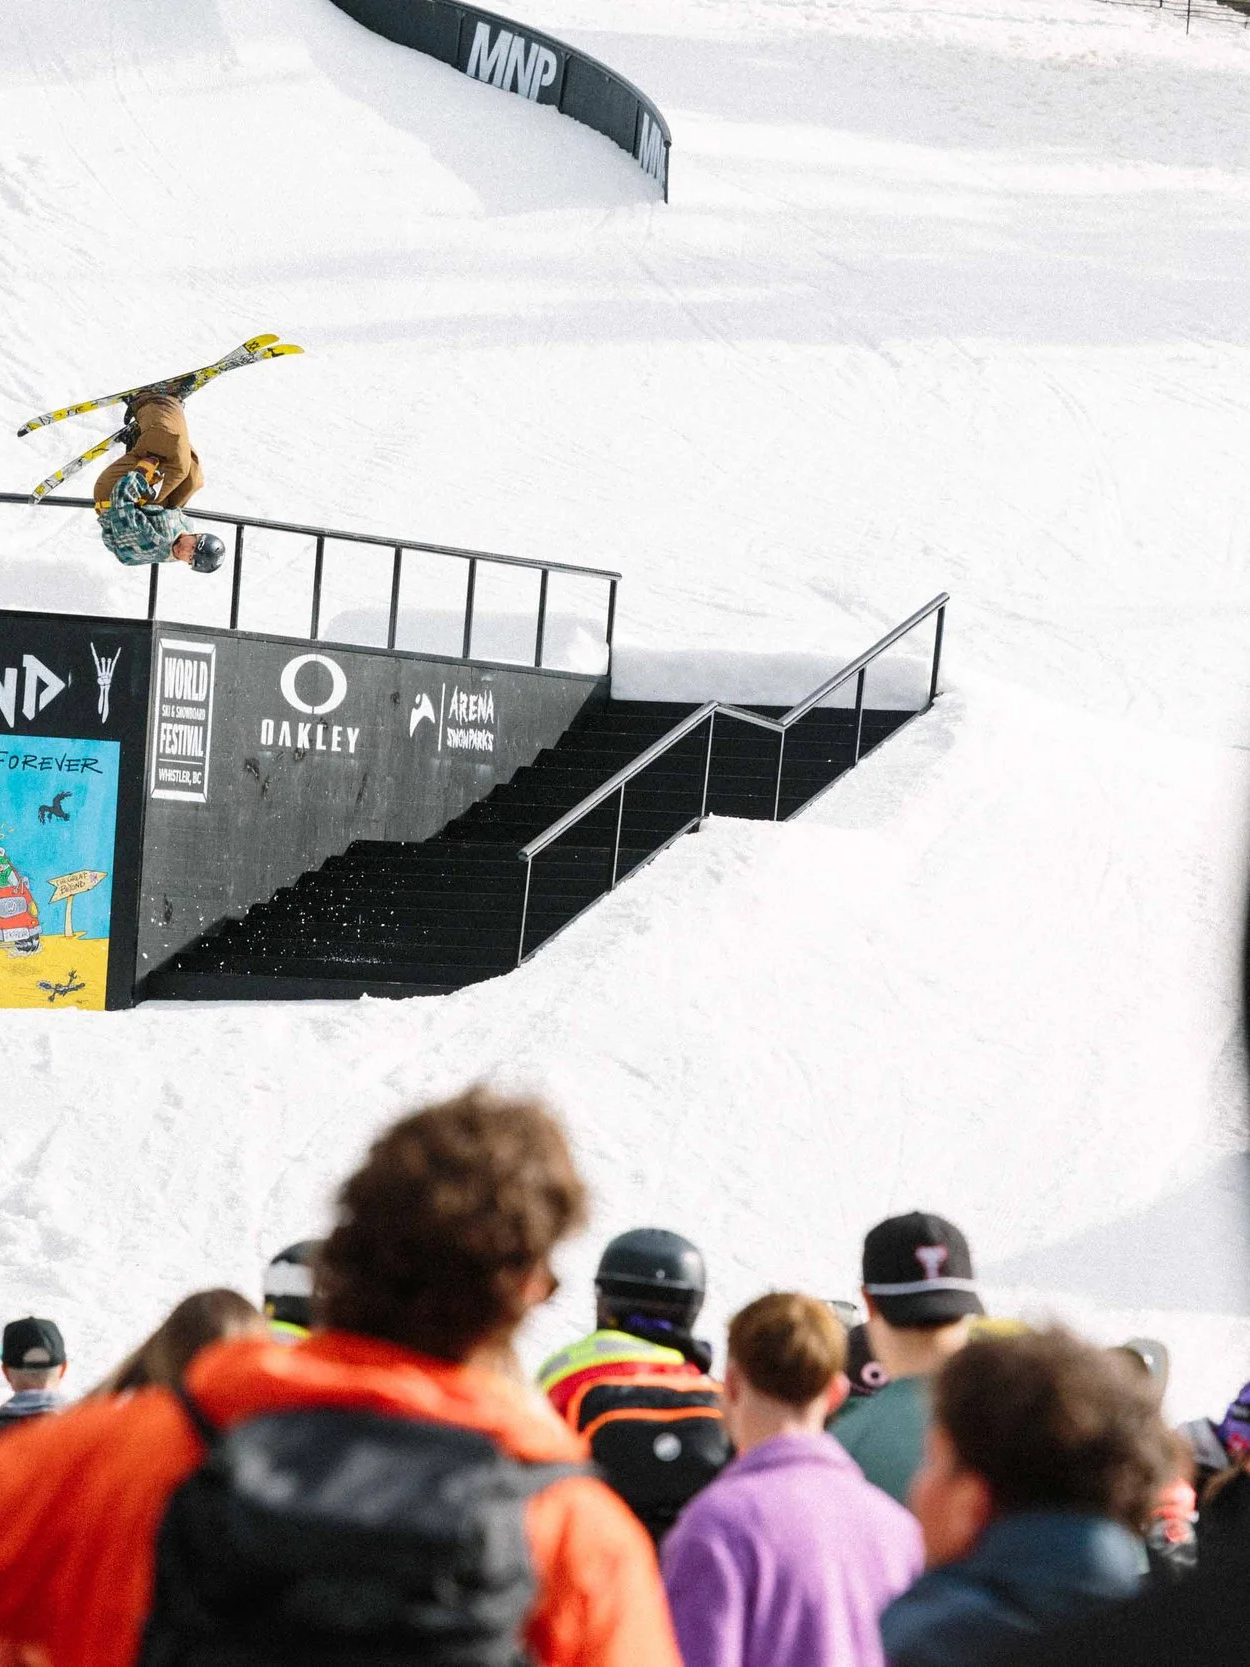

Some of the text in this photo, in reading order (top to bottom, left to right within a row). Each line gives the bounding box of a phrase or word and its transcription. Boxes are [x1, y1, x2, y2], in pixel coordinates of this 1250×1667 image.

[466, 21, 557, 102] MNP
[164, 656, 208, 702] WORLD
[161, 704, 170, 718] SKI
[447, 685, 494, 725] ARENA
[159, 722, 204, 757] FESTIVAL
[260, 718, 361, 753] OAKLEY
[446, 727, 494, 752] SNOWPARKS
[158, 767, 203, 786] WHISTLER, BC
